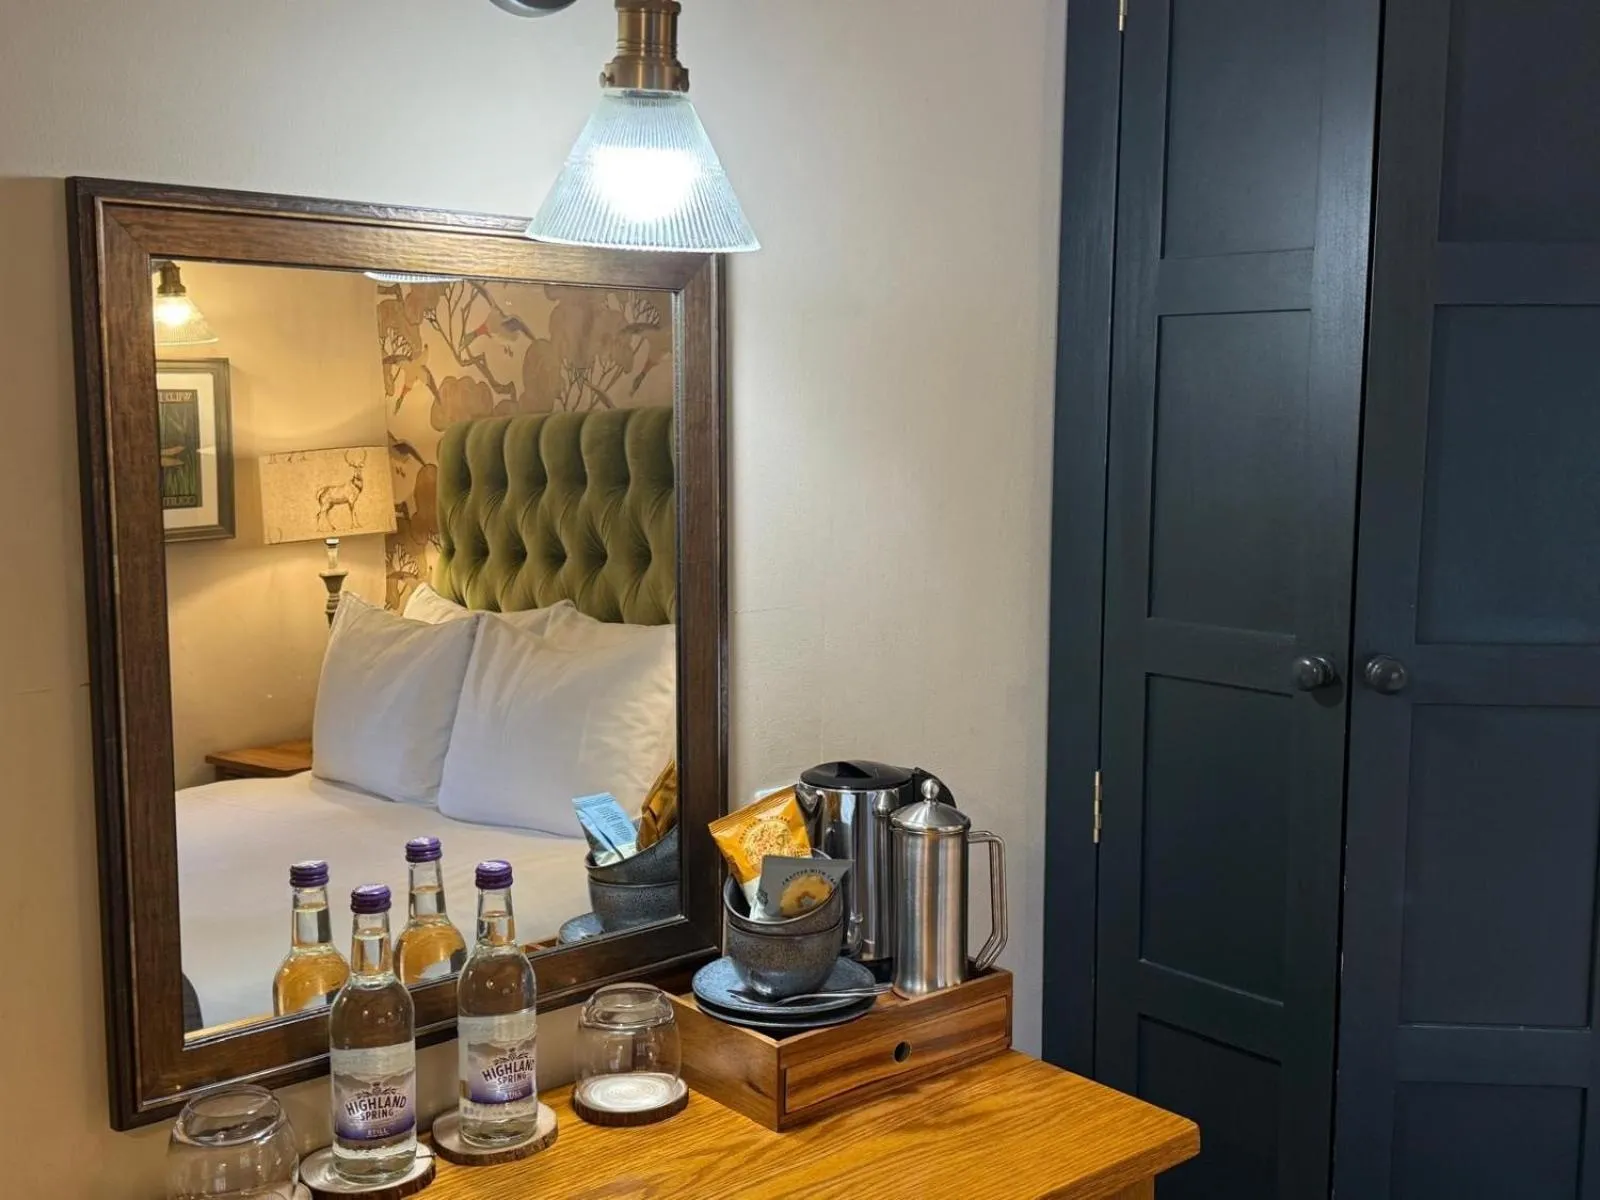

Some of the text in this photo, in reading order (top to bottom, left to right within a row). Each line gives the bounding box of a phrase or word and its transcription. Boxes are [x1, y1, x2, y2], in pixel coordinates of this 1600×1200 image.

[497, 1072, 527, 1085] SPRING
[345, 1095, 407, 1117] HIGHLAND
[360, 1109, 394, 1121] SPRING
